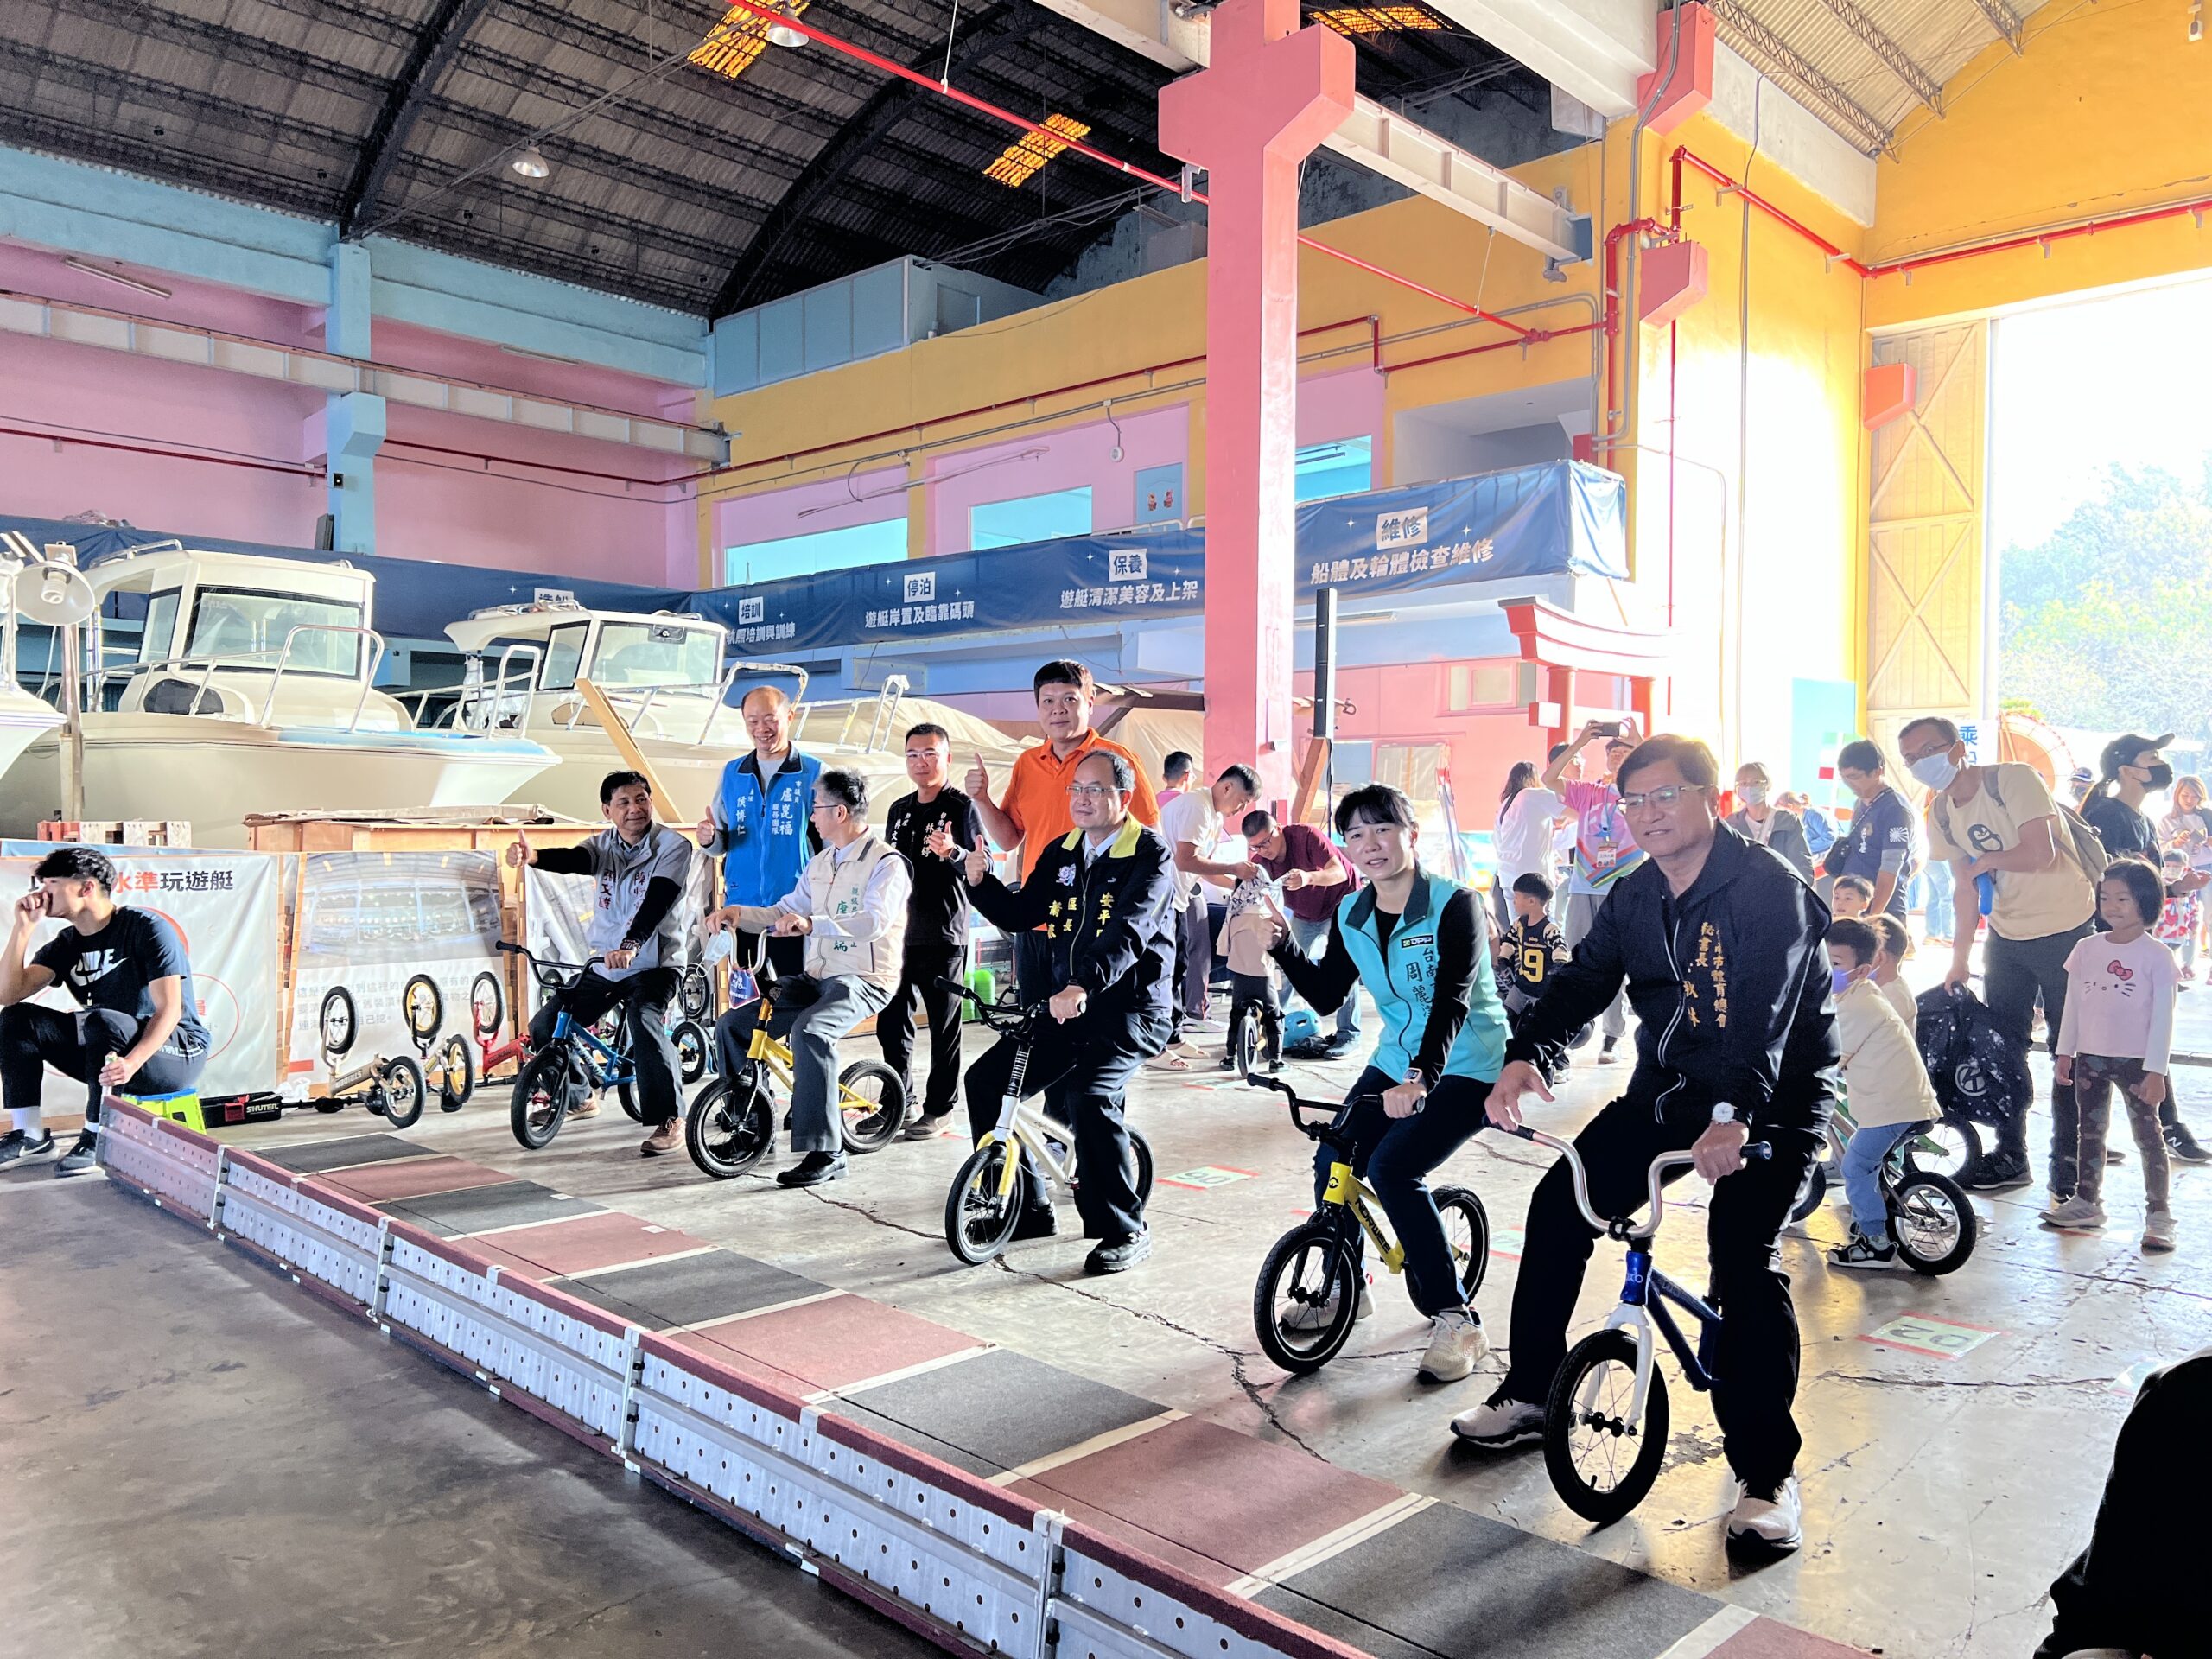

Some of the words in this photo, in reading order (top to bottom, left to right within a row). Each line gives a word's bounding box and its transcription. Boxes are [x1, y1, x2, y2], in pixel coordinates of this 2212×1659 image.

[1382, 515, 1421, 542] 維修
[1113, 554, 1143, 575] 保養
[1310, 537, 1494, 585] 船體及輪體檢查維修
[907, 578, 931, 597] 停泊
[1060, 580, 1198, 609] 遊艇清潔美容及上架
[741, 602, 760, 619] 培訓
[865, 601, 975, 628] 遊艇岸置及臨靠碼頭
